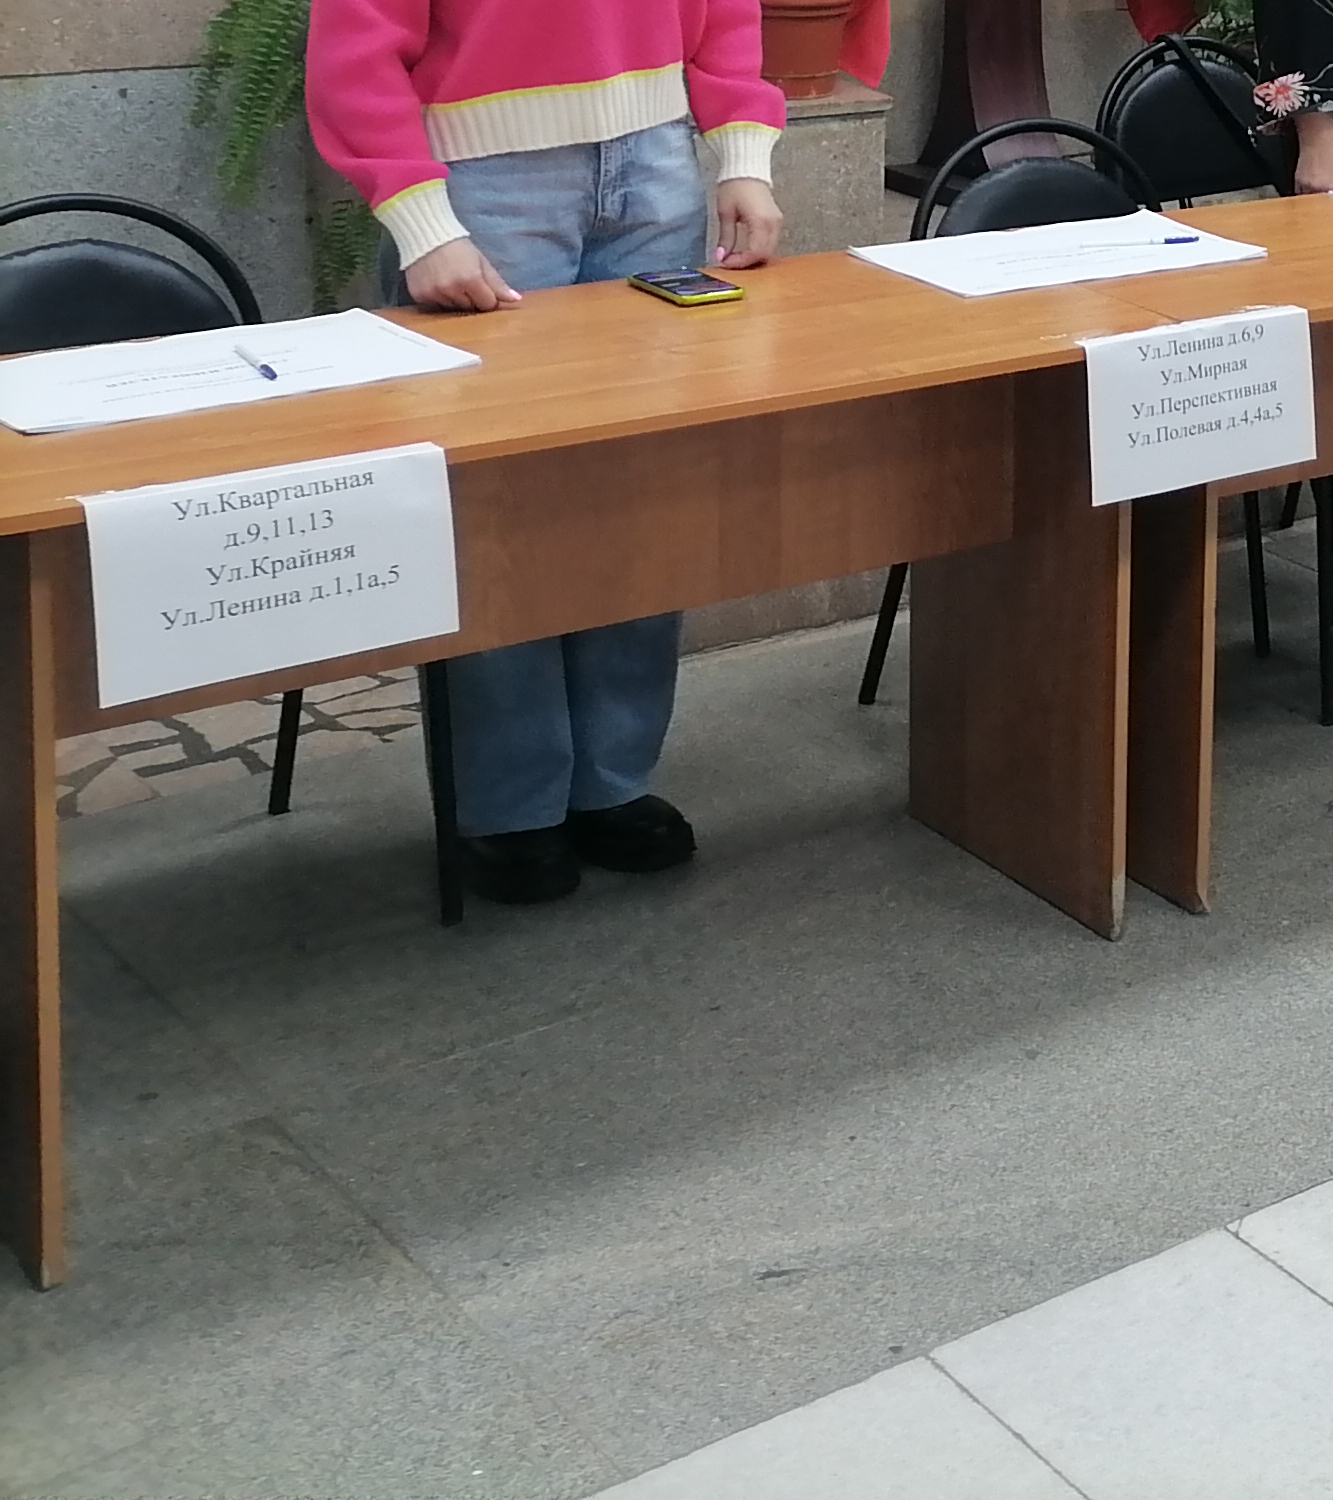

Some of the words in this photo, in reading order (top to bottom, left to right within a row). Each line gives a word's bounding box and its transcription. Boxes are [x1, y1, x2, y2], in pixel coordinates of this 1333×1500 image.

[1137, 335, 1224, 362] Ул.Ленина
[1227, 323, 1265, 345] д.6,9
[1160, 357, 1248, 387] Ул.Мирная
[1131, 380, 1278, 420] Ул.Перспективная
[1127, 417, 1223, 449] Ул.Полевая
[1226, 402, 1283, 431] д.4,4а,5
[171, 469, 376, 522] Ул.Квартальная
[223, 509, 335, 551] д.9,11,13
[205, 542, 357, 587] Ул.Крайняя
[159, 588, 302, 631] Ул.Ленина
[308, 564, 401, 603] д.1,1а,5
